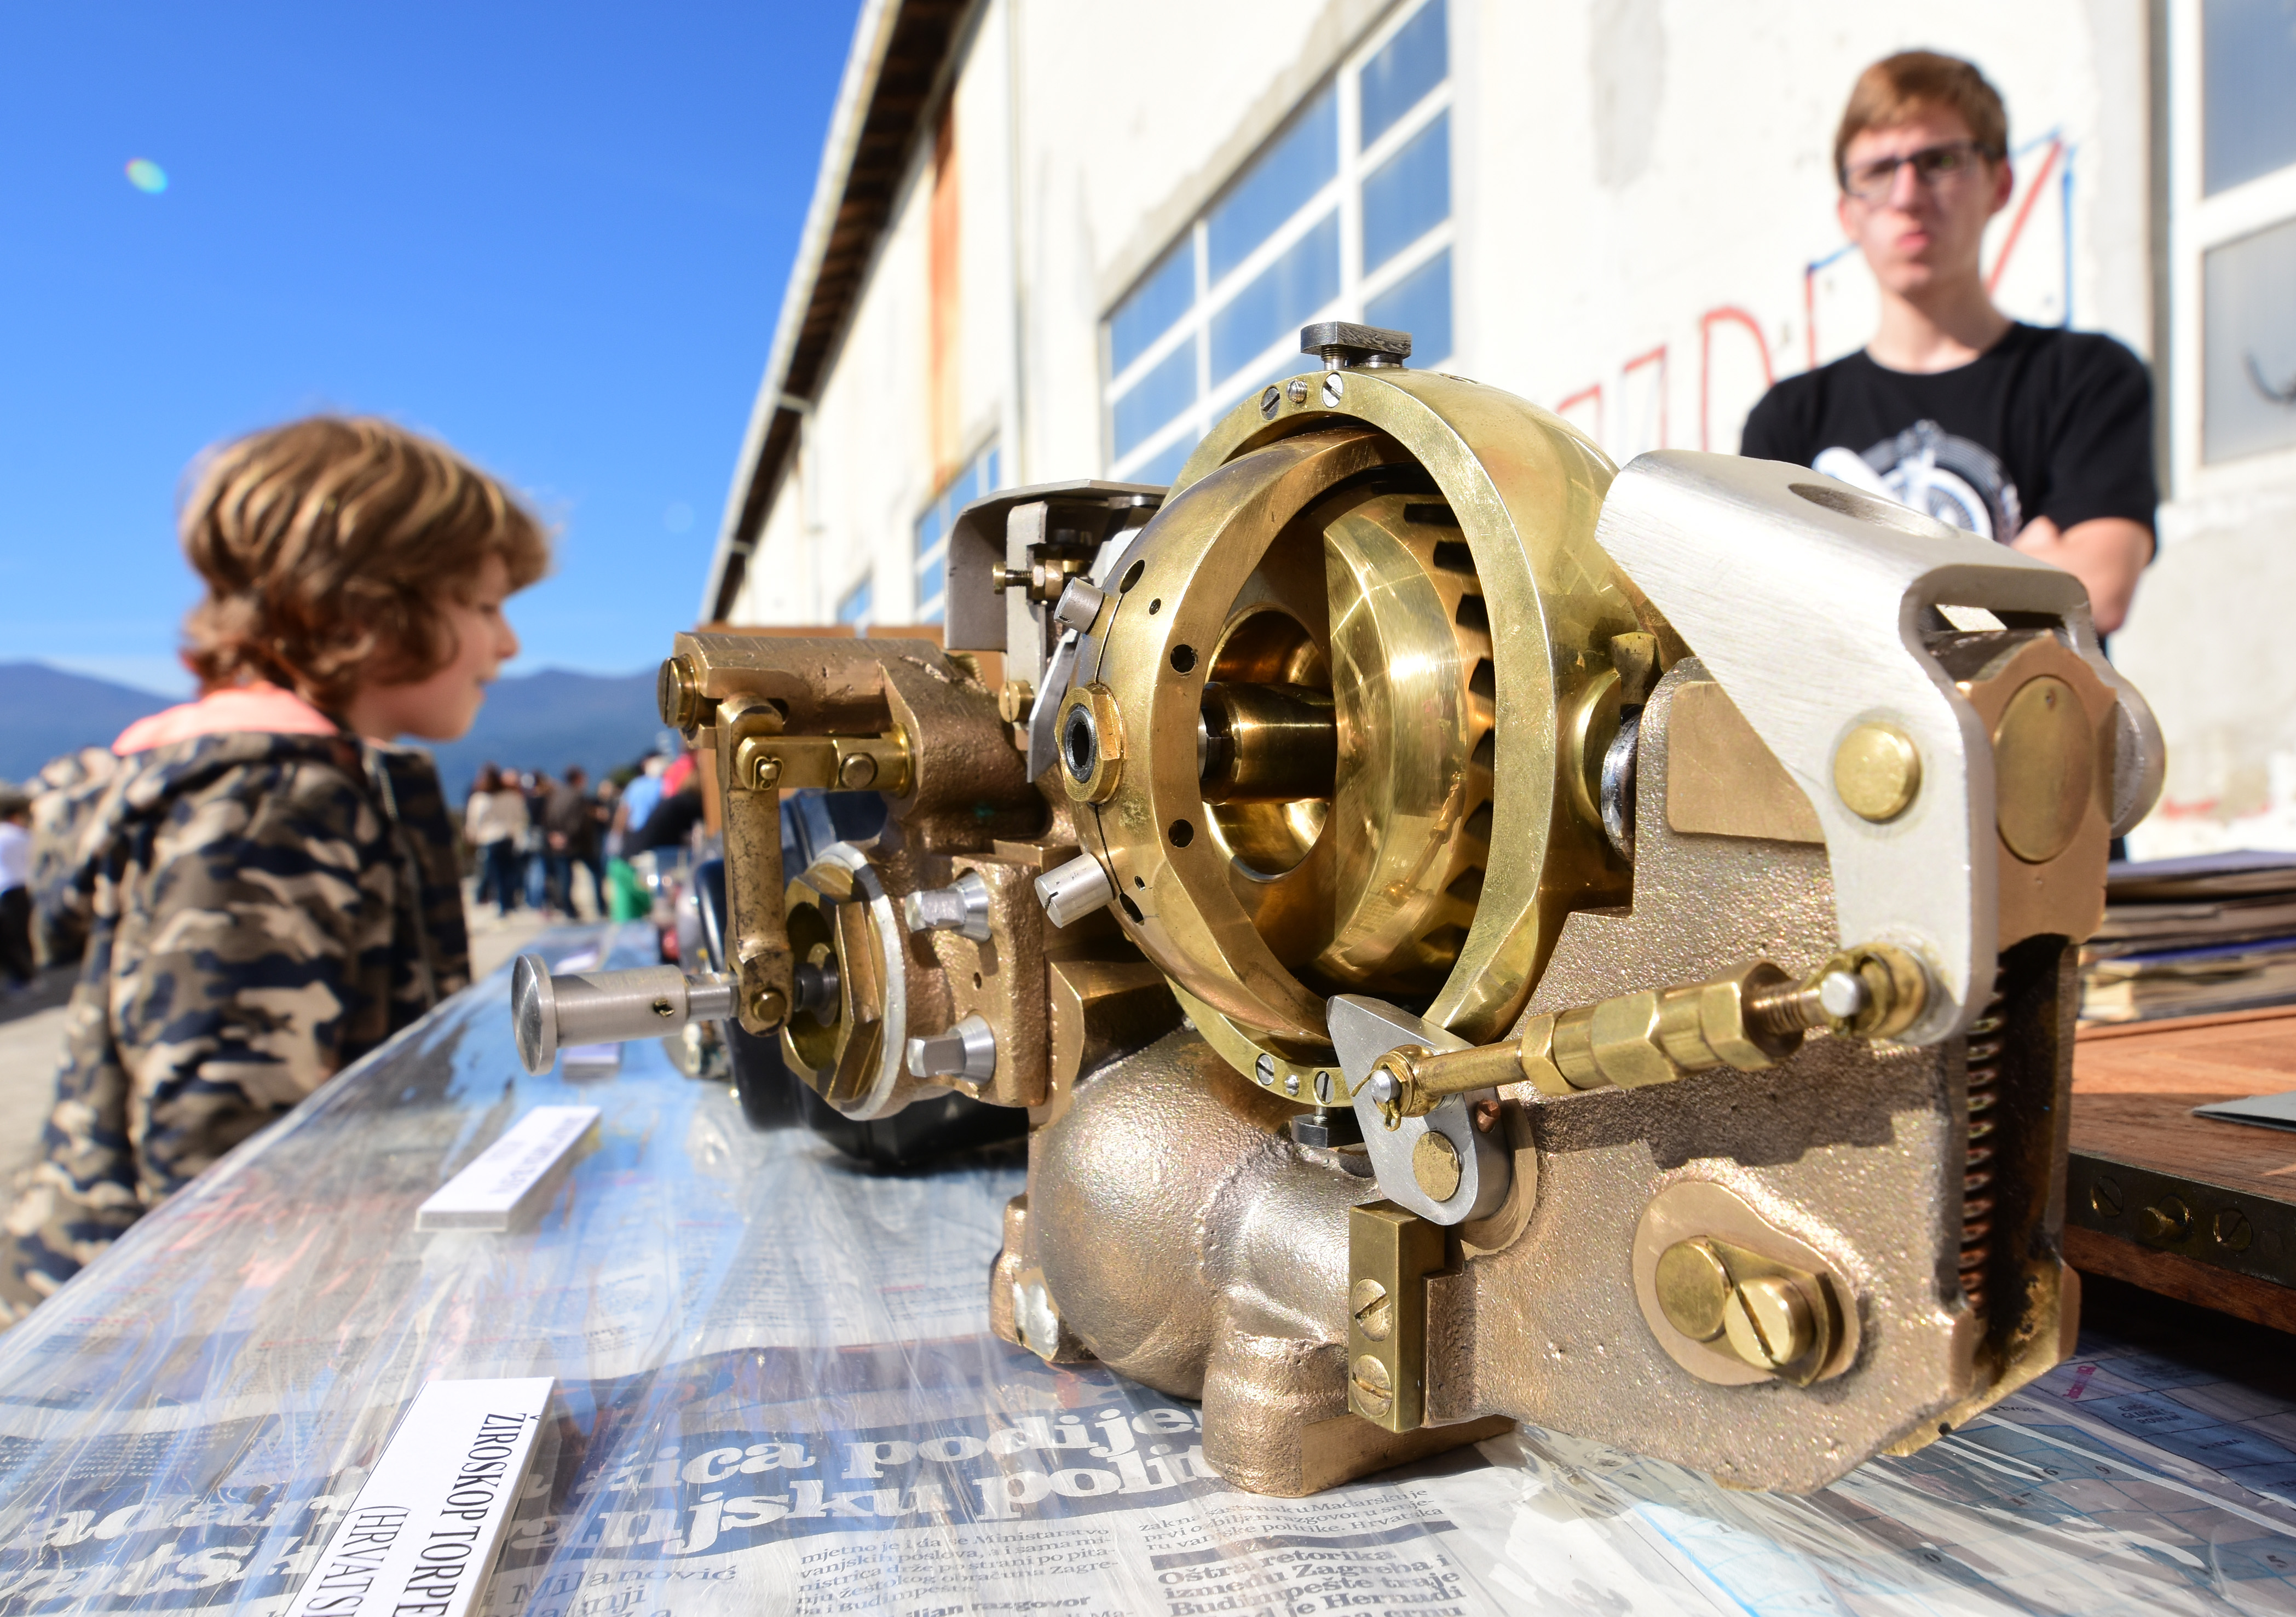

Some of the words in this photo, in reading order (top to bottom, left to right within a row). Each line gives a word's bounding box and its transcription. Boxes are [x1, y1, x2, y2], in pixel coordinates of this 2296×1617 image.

[504, 1480, 953, 1555] anjsku
[972, 1443, 1222, 1520] polit
[1143, 1527, 1186, 1543] prvi
[1273, 1511, 1360, 1525] razgovor
[1261, 1522, 1345, 1534] politike.
[1351, 1507, 1444, 1529] Hrvatska
[971, 1529, 1109, 1545] Ministarstvo
[301, 1506, 411, 1617] (HRVATS
[798, 1567, 882, 1592] nistrica
[1037, 1554, 1064, 1566] po
[1068, 1547, 1115, 1562] pita-
[801, 1554, 892, 1578] vanjskih
[1015, 1540, 1071, 1555] sama
[1049, 1561, 1118, 1574] Zagre-
[1158, 1562, 1255, 1585] Oštra
[1291, 1560, 1434, 1579] Zagreba
[1437, 1554, 1452, 1567] i
[1167, 1575, 1374, 1616] Budimpešte
[1381, 1572, 1461, 1589] traje
